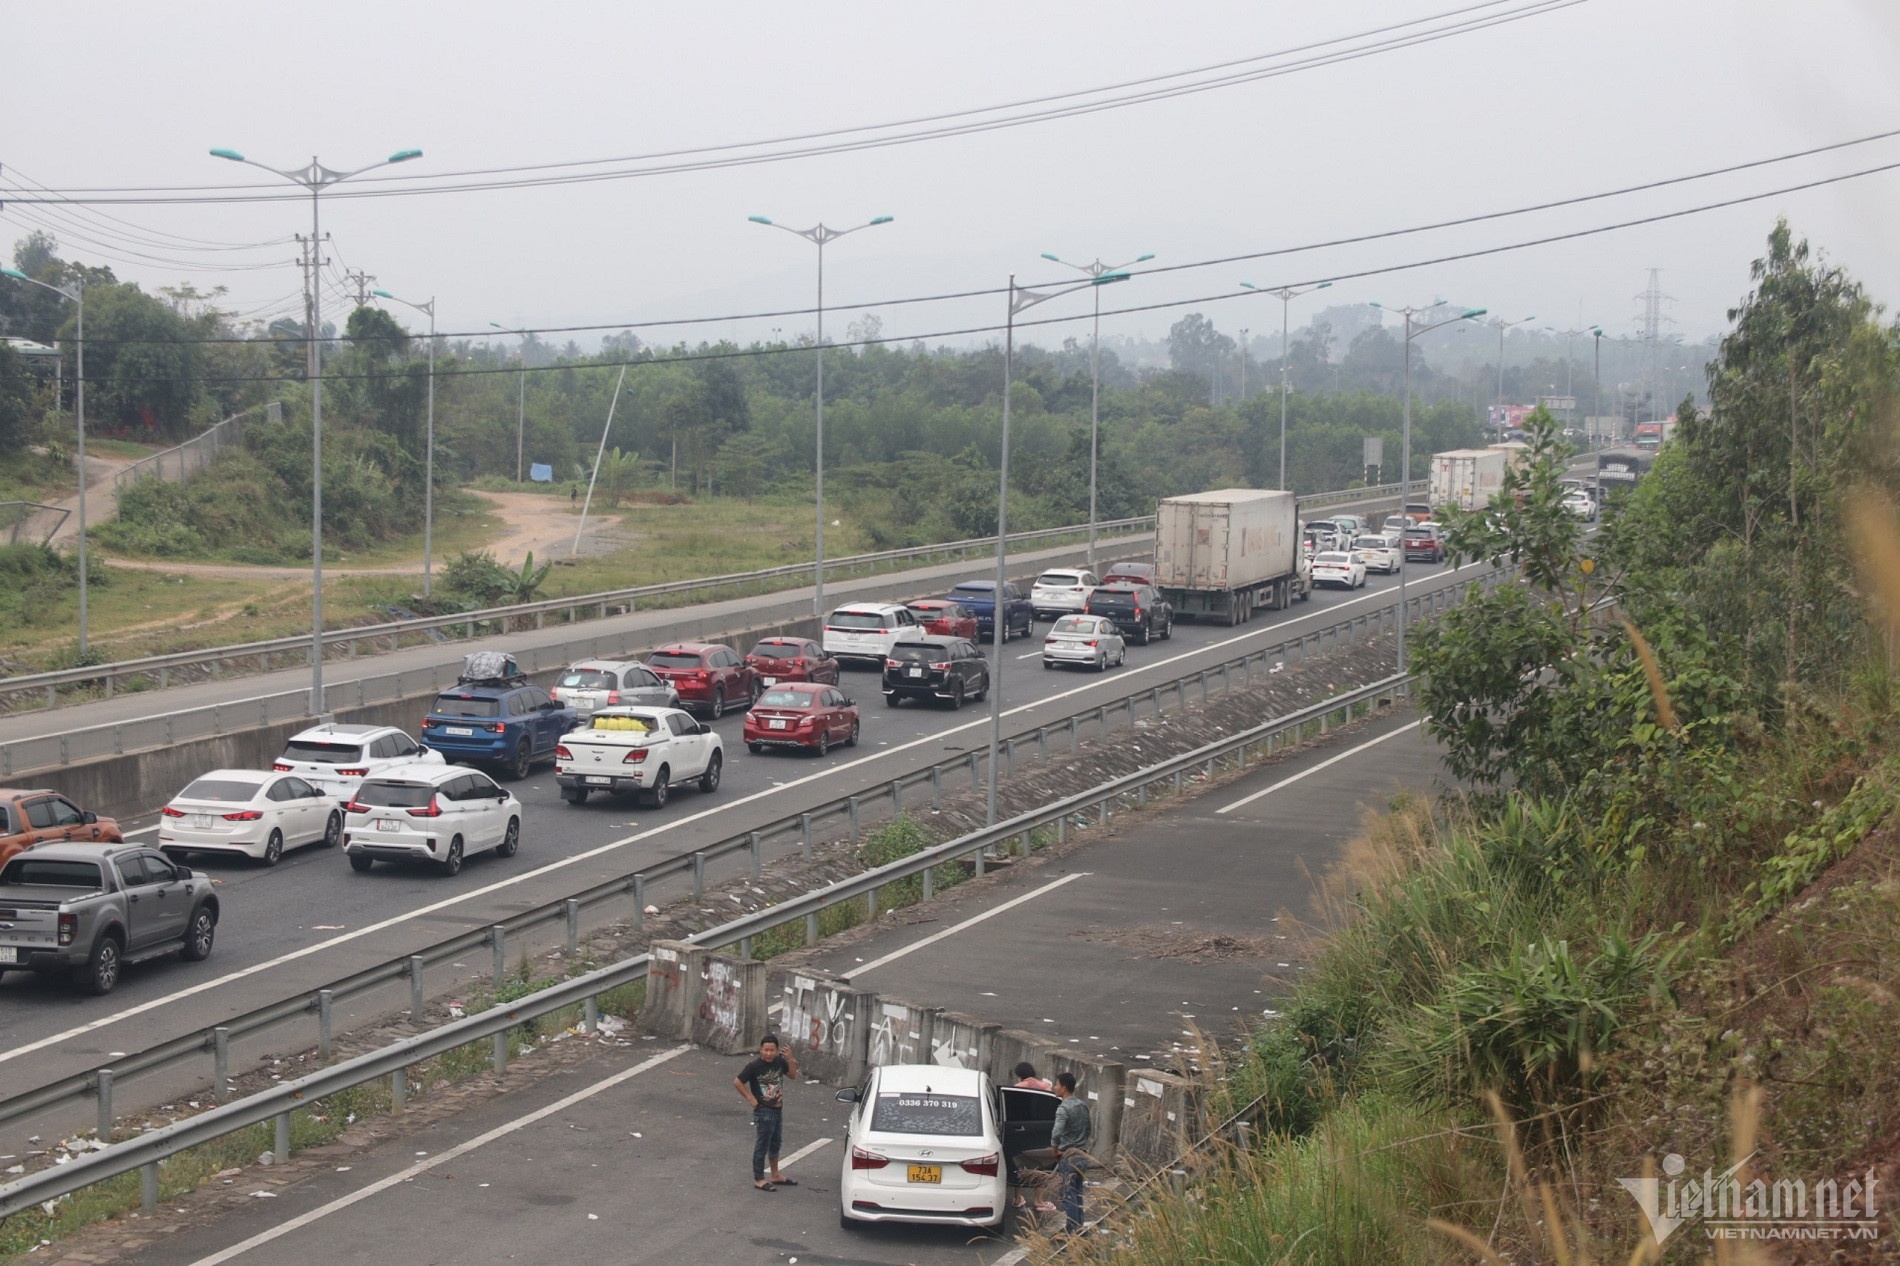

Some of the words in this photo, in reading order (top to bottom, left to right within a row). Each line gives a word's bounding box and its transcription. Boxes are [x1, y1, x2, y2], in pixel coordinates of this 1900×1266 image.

[0, 934, 54, 943] GER
[899, 1099, 921, 1107] 0336
[941, 1101, 958, 1109] 319
[917, 1166, 932, 1174] 73A
[911, 1174, 938, 1183] 154.37
